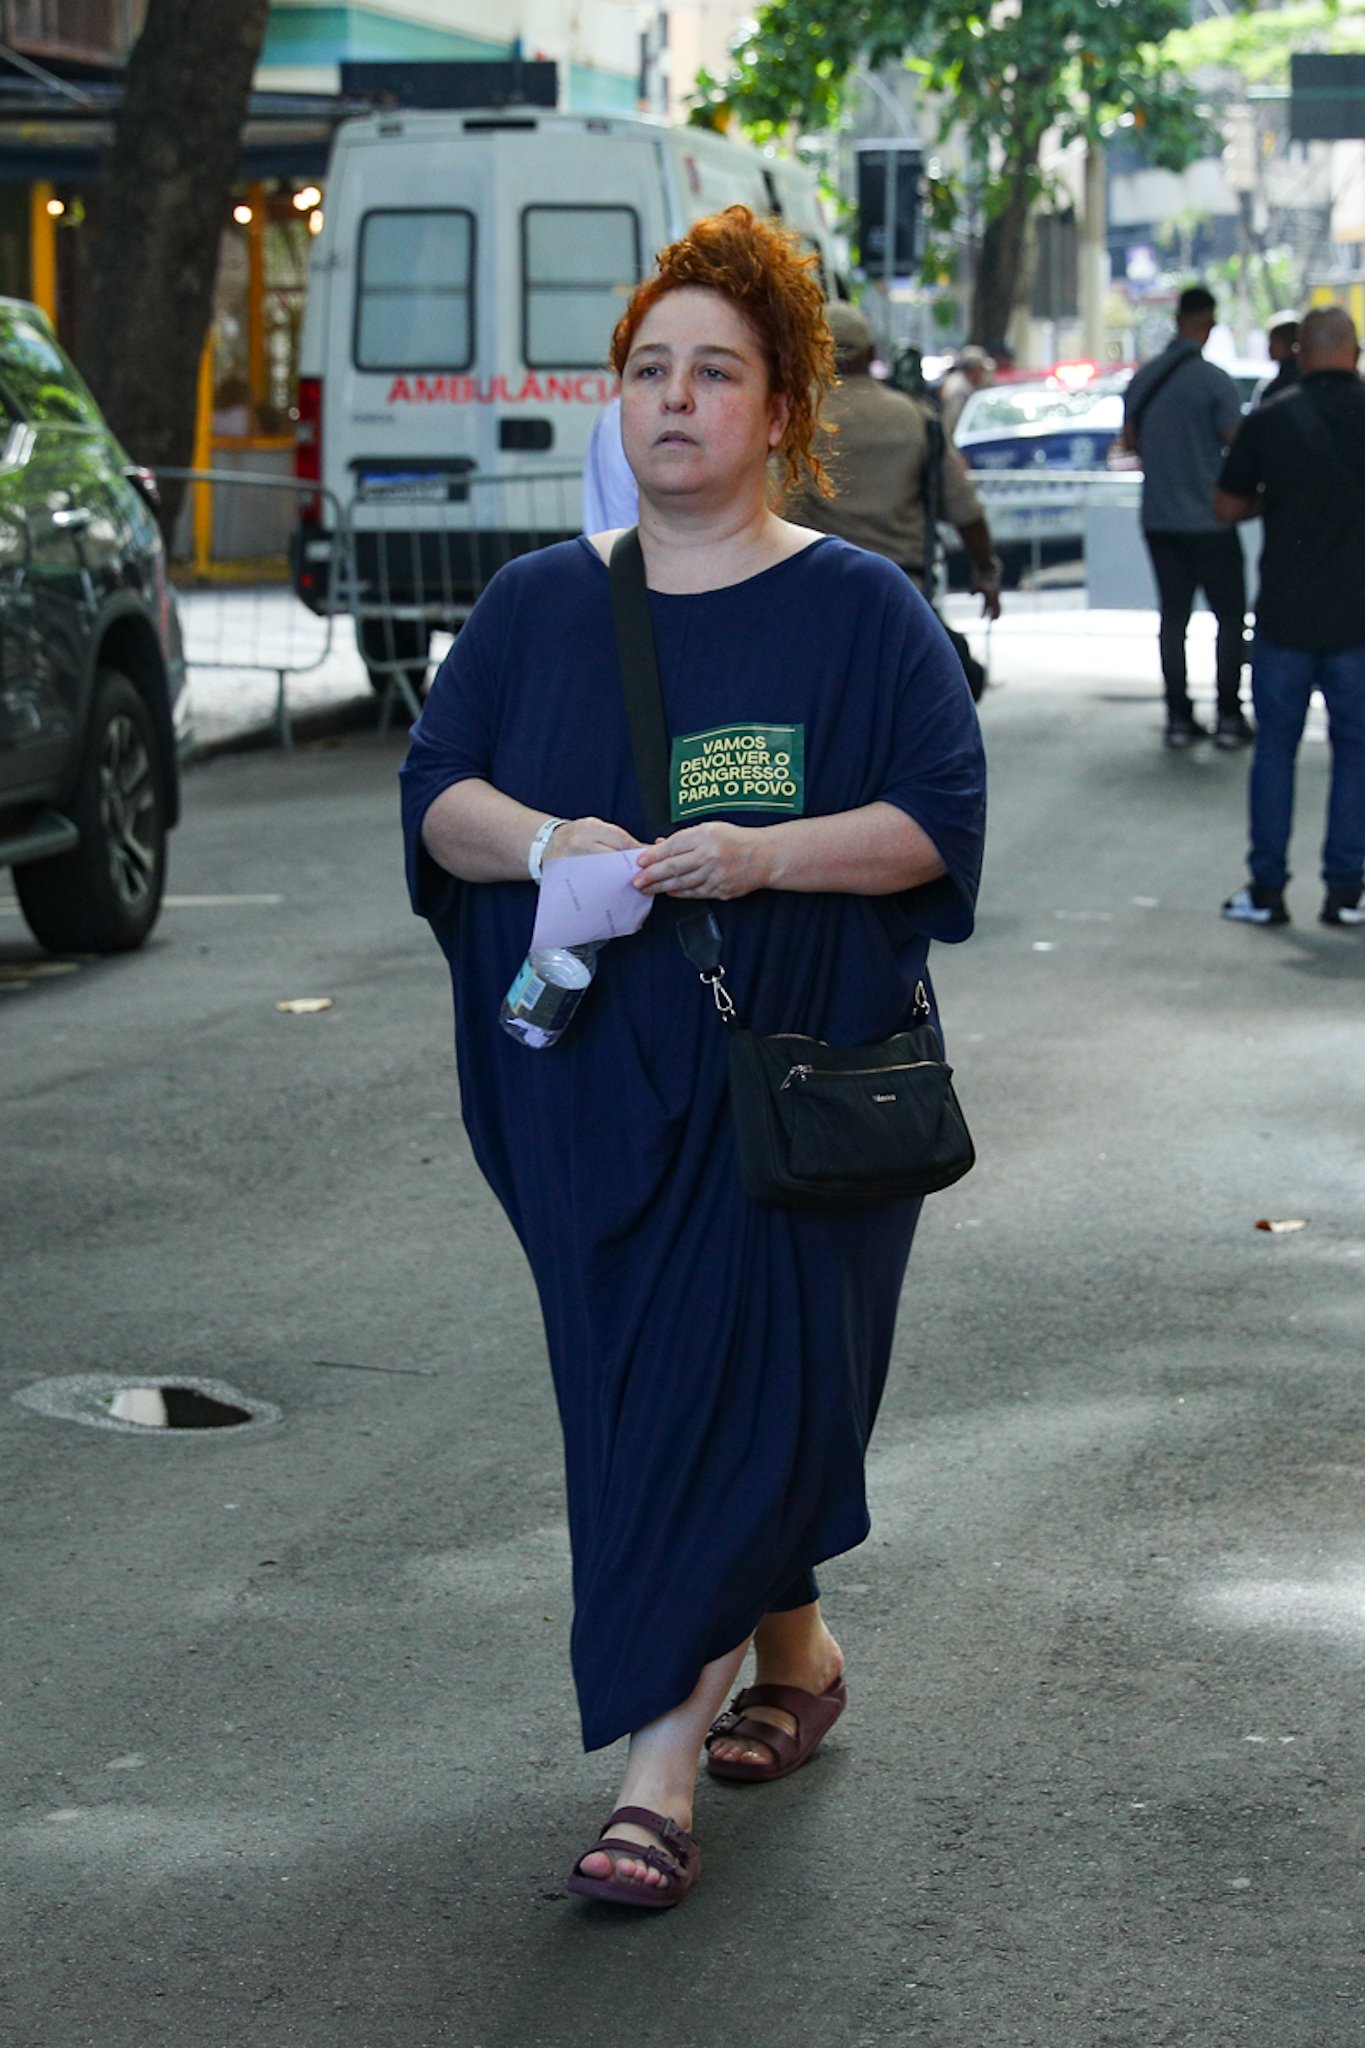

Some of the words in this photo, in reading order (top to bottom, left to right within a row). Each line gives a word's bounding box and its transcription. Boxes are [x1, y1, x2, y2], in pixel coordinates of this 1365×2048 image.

[703, 735, 767, 755] VAMOS
[680, 751, 770, 774] DEVOLVER
[774, 752, 790, 766] O
[680, 765, 790, 788] CONGRESSO
[678, 783, 720, 805] PARA
[723, 781, 739, 796] O
[743, 780, 797, 797] POVO
